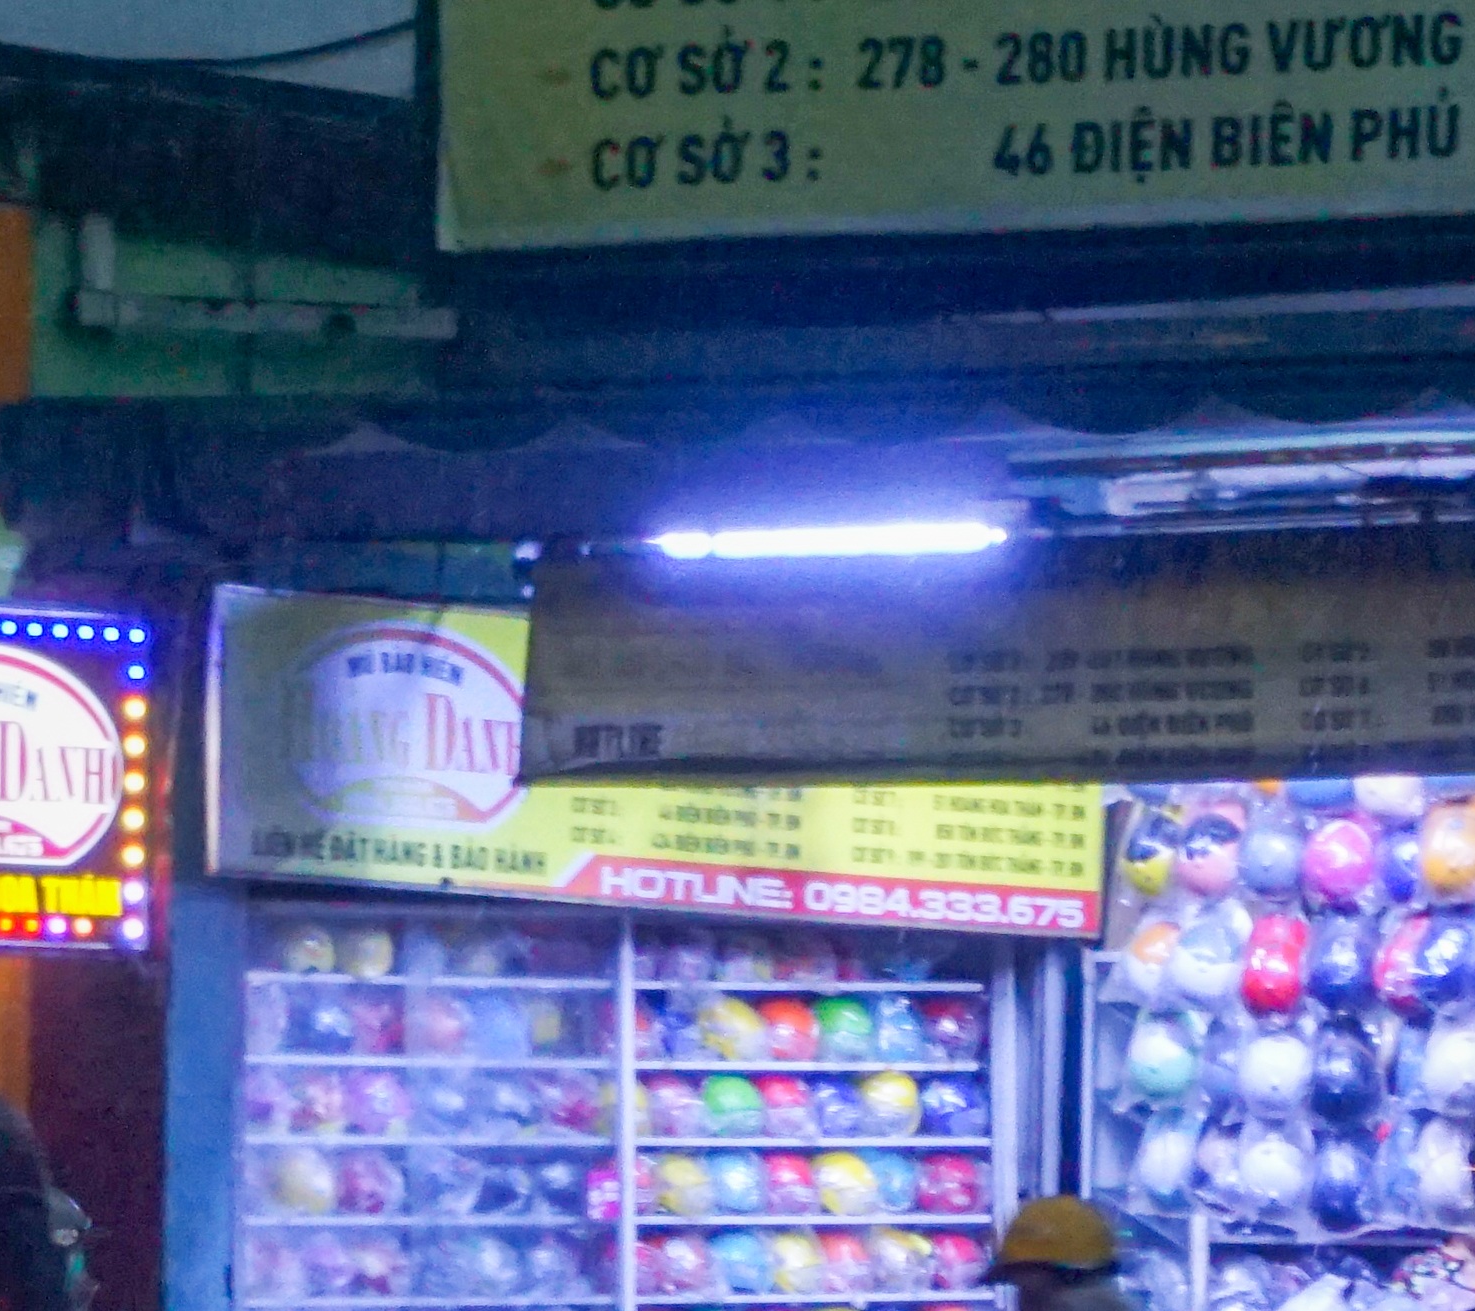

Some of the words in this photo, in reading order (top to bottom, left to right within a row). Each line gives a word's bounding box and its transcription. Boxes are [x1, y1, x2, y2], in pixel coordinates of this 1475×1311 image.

[590, 43, 664, 100] CƠ
[677, 25, 750, 96] SỞ
[856, 35, 945, 91] 278
[995, 31, 1088, 86] 280
[1104, 14, 1250, 82] HÙNG
[1266, 12, 1464, 73] VƯƠNG
[590, 134, 664, 191] CƠ
[677, 114, 750, 186] SỞ
[994, 122, 1052, 176] 46
[1070, 105, 1191, 184] ĐIỆN
[1210, 99, 1333, 168] BIÊN
[1350, 86, 1461, 163] PHỦ
[804, 879, 1085, 929] 0984.333.675
